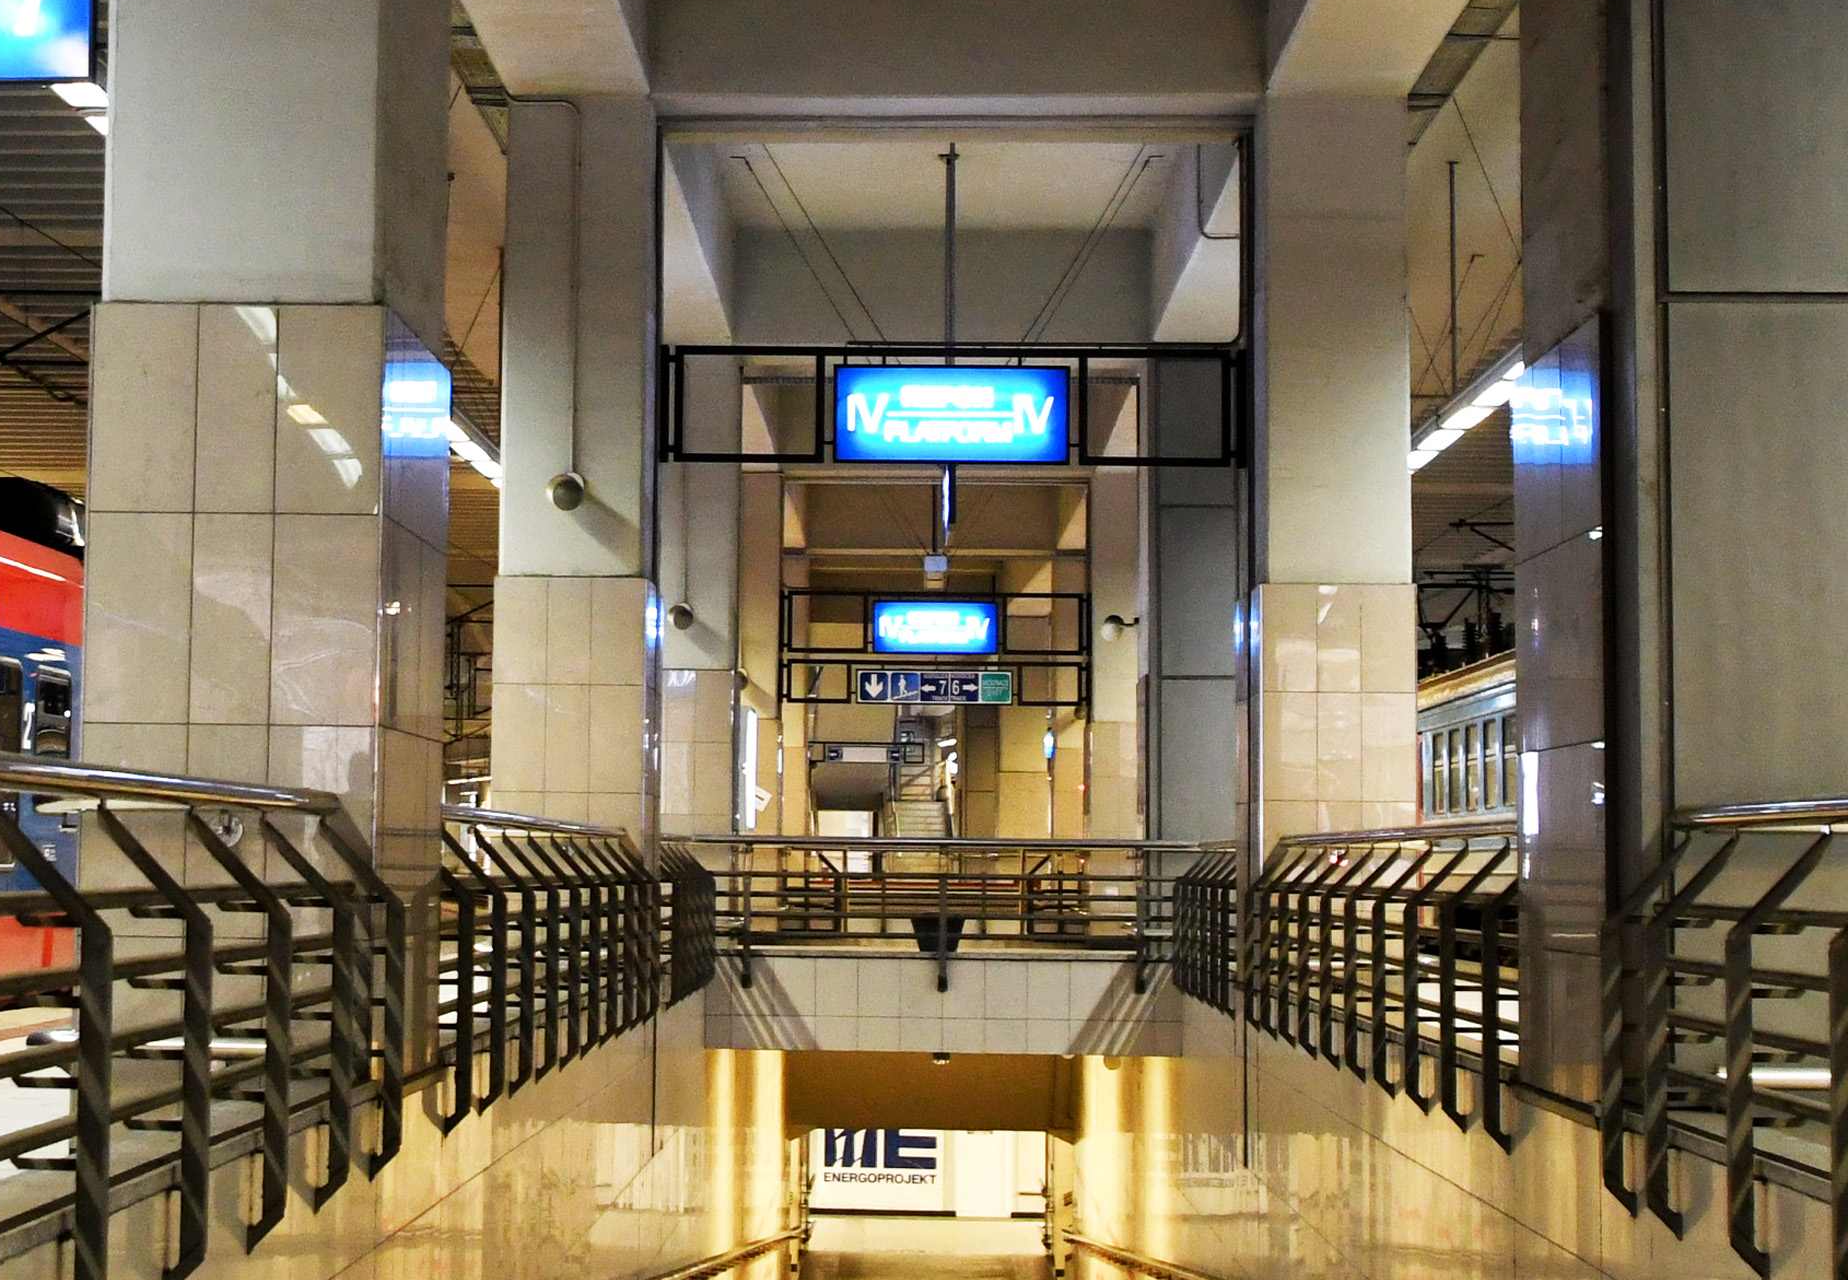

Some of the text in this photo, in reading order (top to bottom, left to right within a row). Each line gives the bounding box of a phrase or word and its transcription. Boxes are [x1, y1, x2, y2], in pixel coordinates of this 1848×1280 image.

[847, 393, 890, 433] IV
[1013, 393, 1054, 434] IV
[883, 420, 1013, 443] PLATFORM
[939, 680, 947, 695] 7
[952, 680, 960, 695] 6
[22, 702, 35, 749] 2
[823, 1172, 937, 1185] ENERGOPROJEKT
